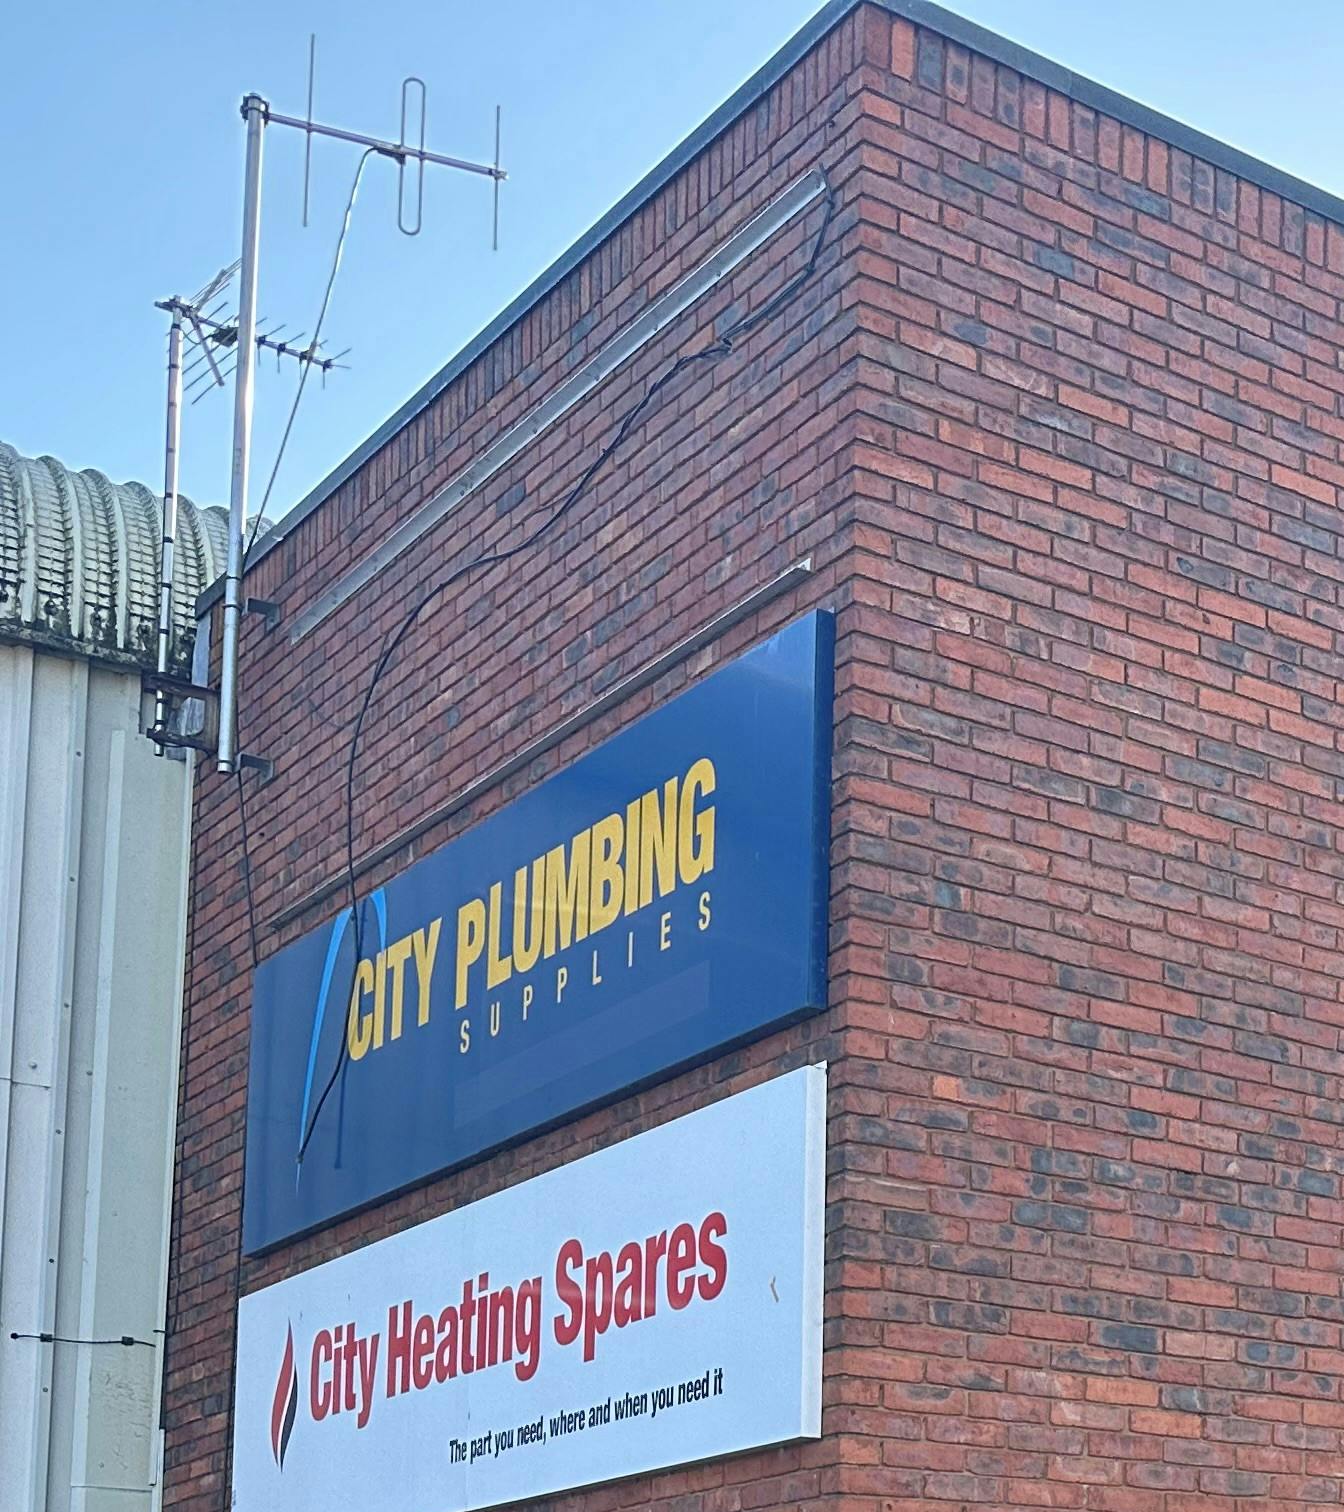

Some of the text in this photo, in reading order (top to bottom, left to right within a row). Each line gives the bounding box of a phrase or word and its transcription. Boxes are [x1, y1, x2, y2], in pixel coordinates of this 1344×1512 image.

[349, 758, 716, 1061] CITY PLUMBING
[459, 891, 711, 1053] SUPPLIES
[310, 1212, 728, 1429] City Heating Spares
[449, 1367, 723, 1464] The part you need, where and when you need it
